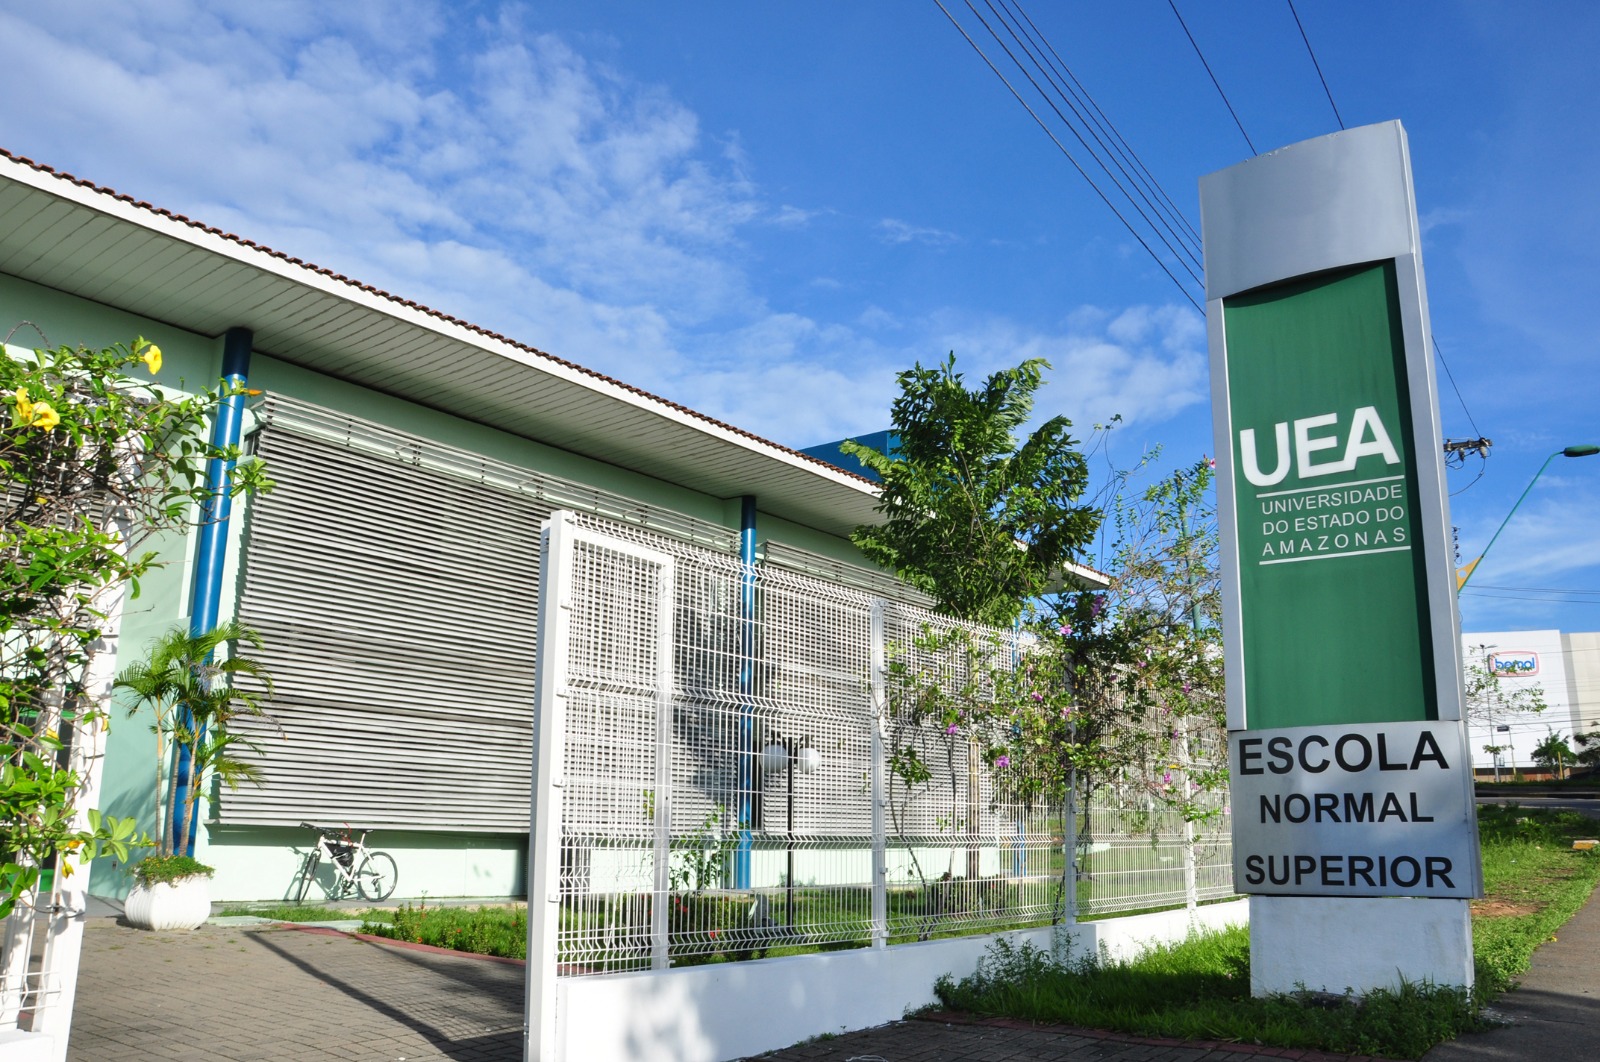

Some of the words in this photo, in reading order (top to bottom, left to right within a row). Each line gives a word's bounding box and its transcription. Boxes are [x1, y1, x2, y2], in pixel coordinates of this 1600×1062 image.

[1240, 406, 1400, 487] UEA
[1262, 484, 1402, 515] UNIVERSIDADE
[1262, 520, 1289, 536] DO
[1294, 511, 1370, 532] ESTADO
[1376, 506, 1404, 522] DO
[1262, 527, 1406, 557] AMAZONAS
[1238, 730, 1449, 775] ESCOLA
[1259, 792, 1435, 824] NORMAL
[1244, 854, 1456, 889] SUPERIOR
